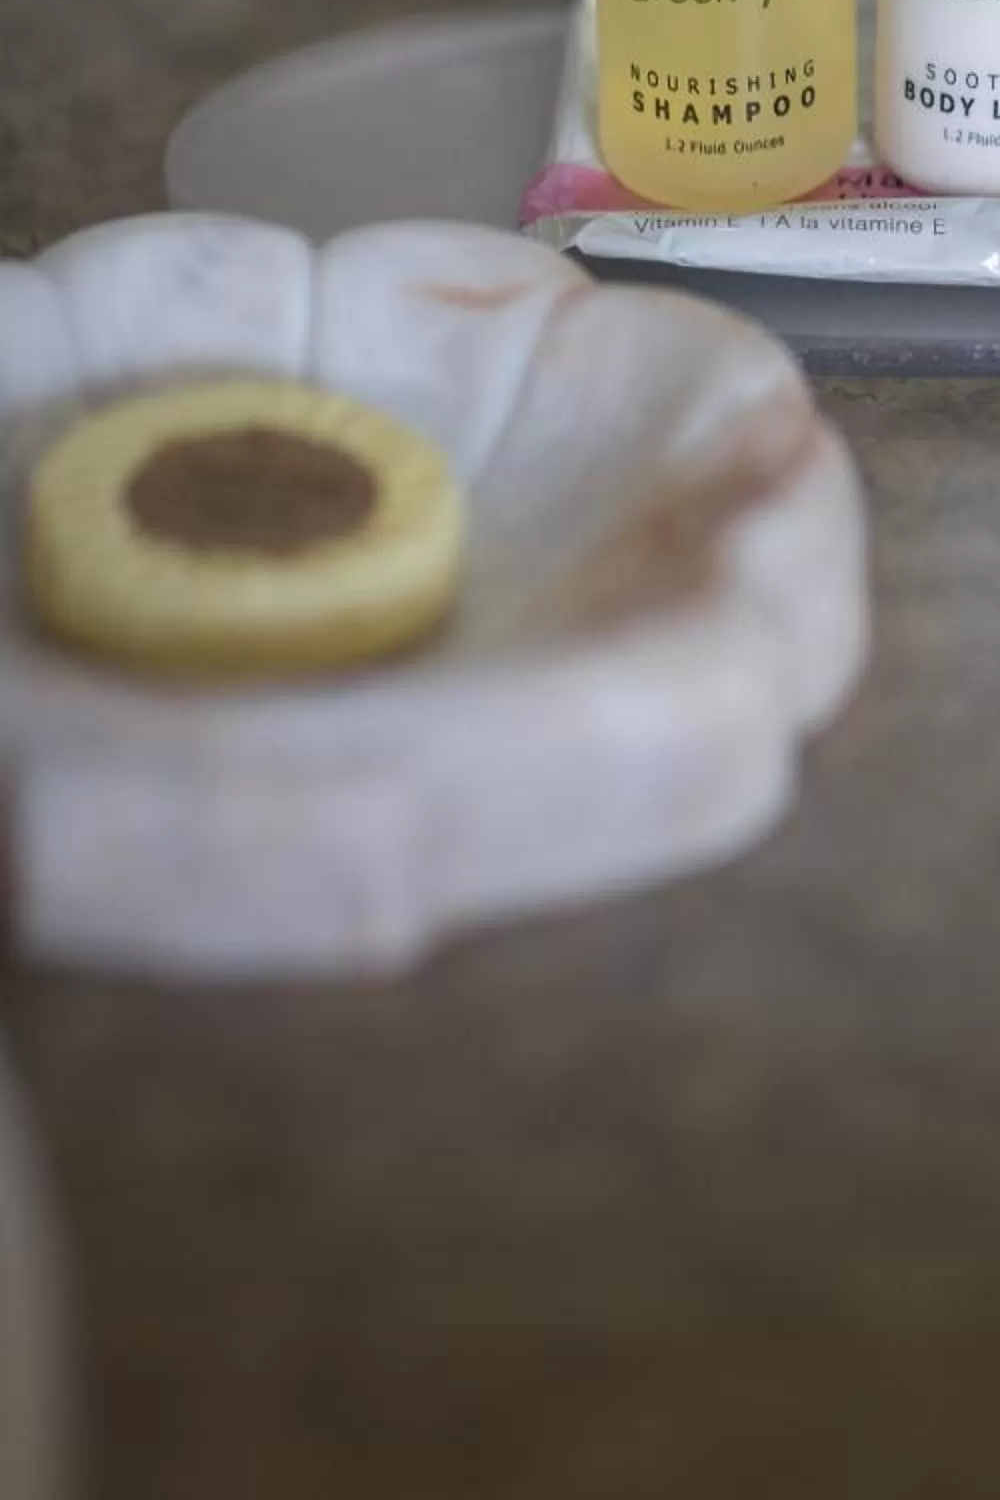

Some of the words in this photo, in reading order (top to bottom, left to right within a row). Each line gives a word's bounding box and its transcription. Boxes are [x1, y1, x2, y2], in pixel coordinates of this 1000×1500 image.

[630, 58, 815, 96] NOURISHING
[632, 85, 815, 125] SHAMPOO
[904, 77, 975, 116] BODY
[665, 136, 685, 153] 1.2
[690, 138, 726, 155] Fluid
[733, 135, 785, 154] Ounces
[943, 128, 963, 145] 1.2
[634, 214, 717, 233] Vitamin
[801, 215, 818, 230] la
[829, 216, 923, 235] vitamine
[933, 218, 946, 235] E
